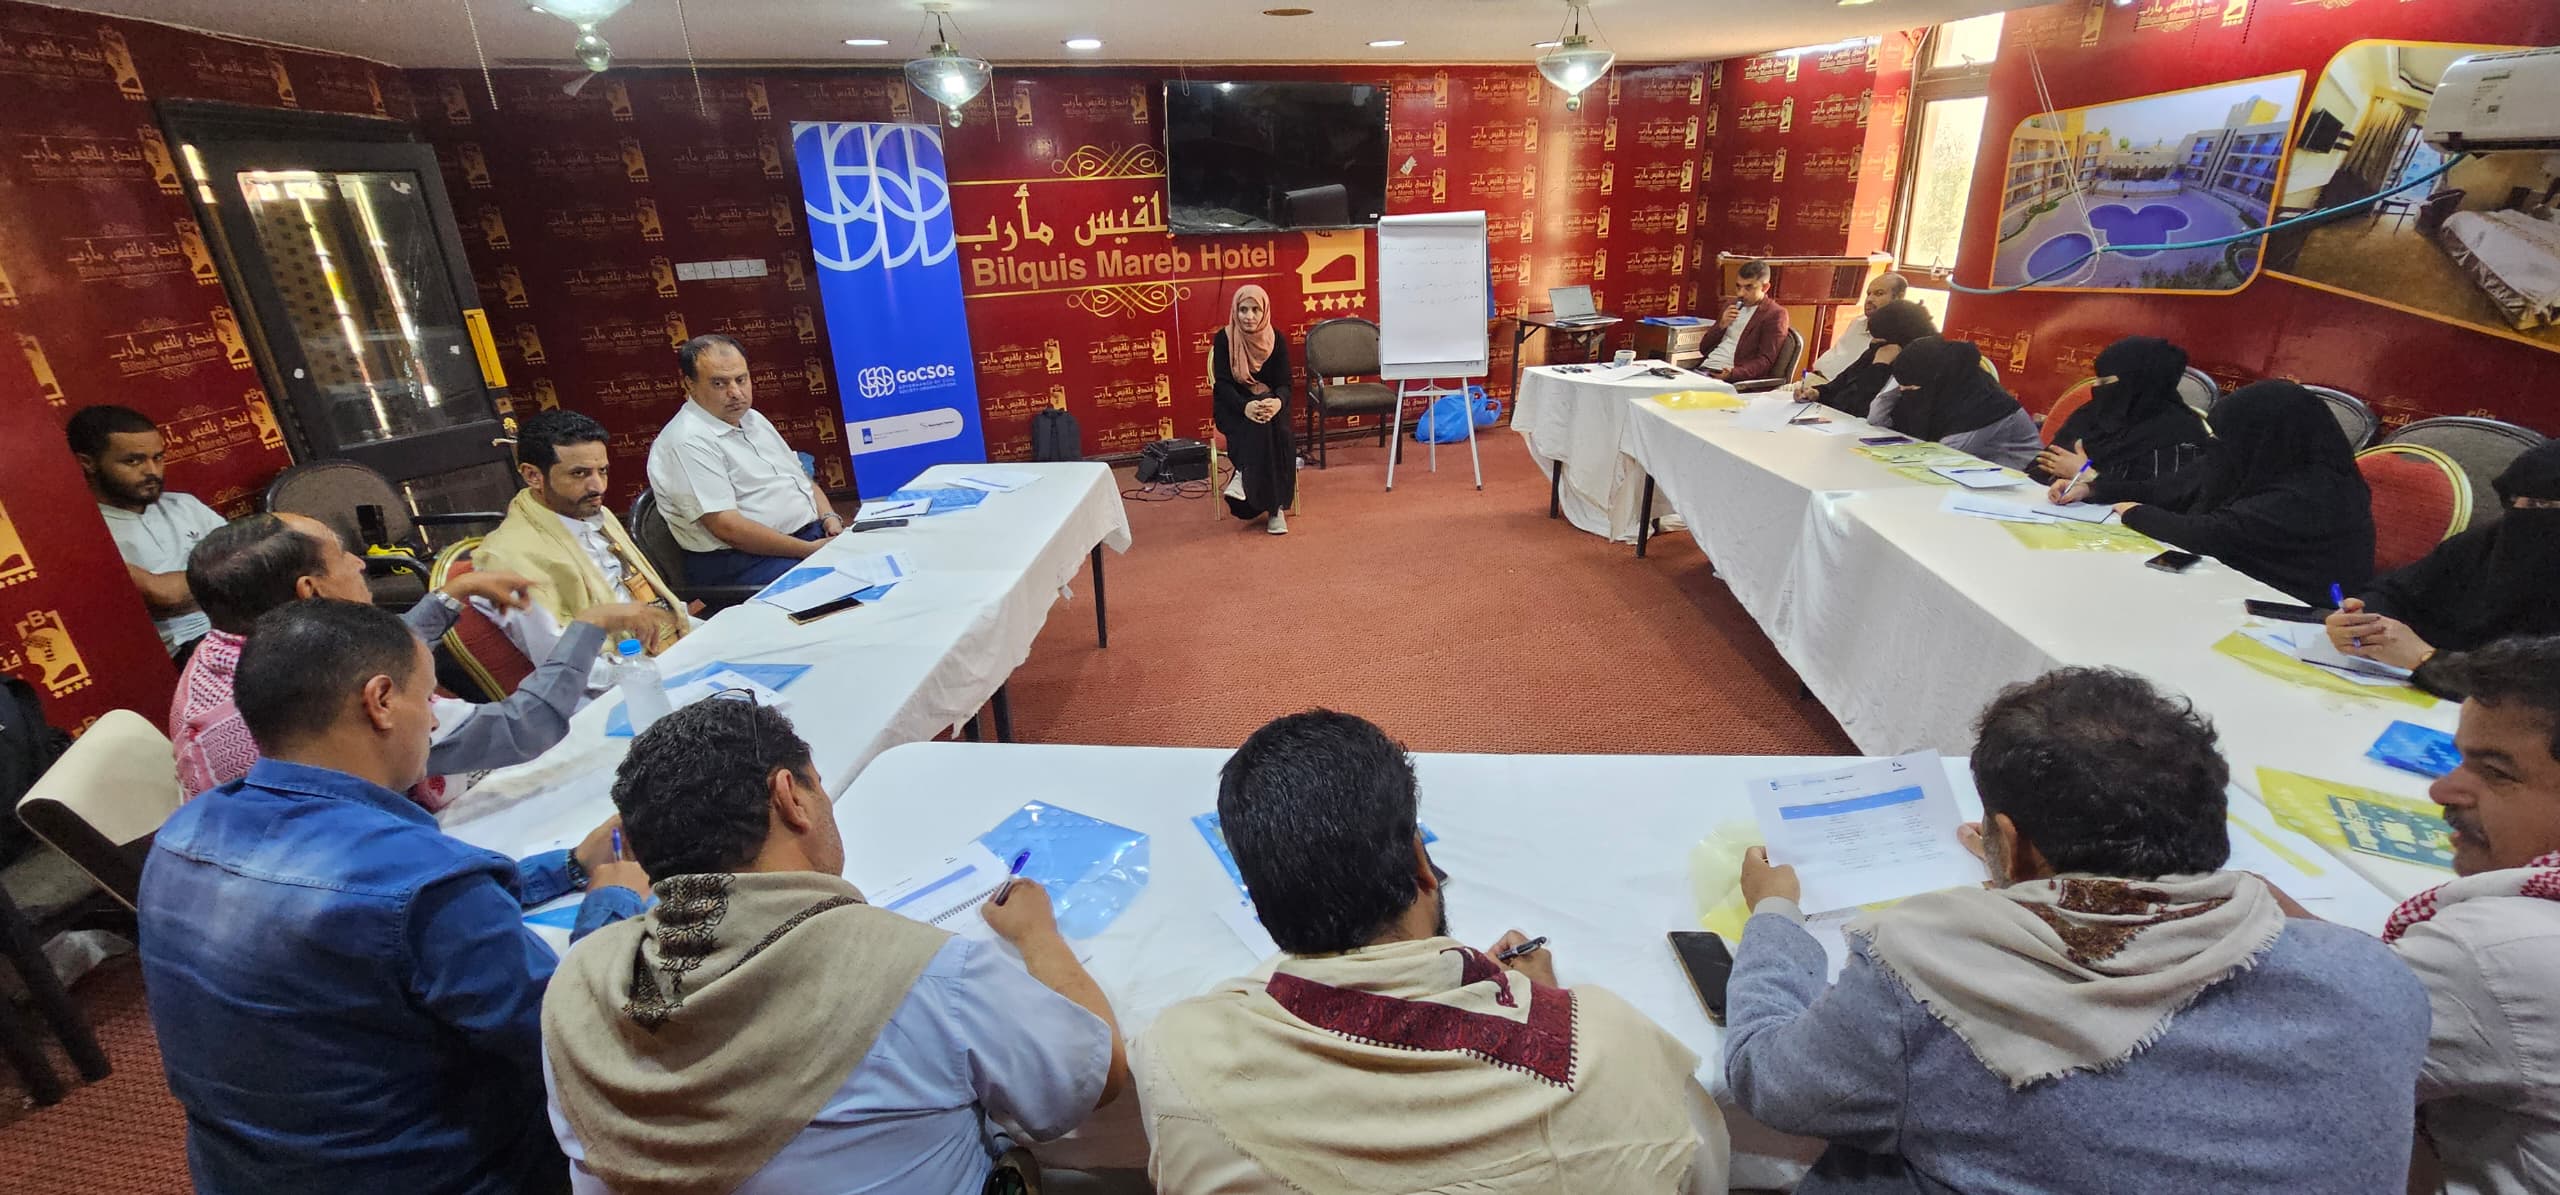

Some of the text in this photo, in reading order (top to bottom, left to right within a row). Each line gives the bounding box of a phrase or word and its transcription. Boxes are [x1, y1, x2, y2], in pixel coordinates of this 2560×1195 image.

[956, 184, 1054, 252] مأرب
[66, 239, 180, 264] فندق بلقيس مأرب
[972, 240, 1274, 290] Bilquis Mareb Hotel
[109, 327, 216, 359] فندق بلقيس مأرب
[1089, 342, 1149, 354] فندق بلقيس مأرب
[980, 351, 1042, 364] فندق بلقيس مأرب
[896, 364, 956, 384] GoCSOs
[1096, 386, 1153, 398] فندق بلقيس مأرب
[187, 420, 218, 442] بلقيس
[222, 412, 248, 432] فندق
[1100, 428, 1156, 441] فندق بلقيس مأرب
